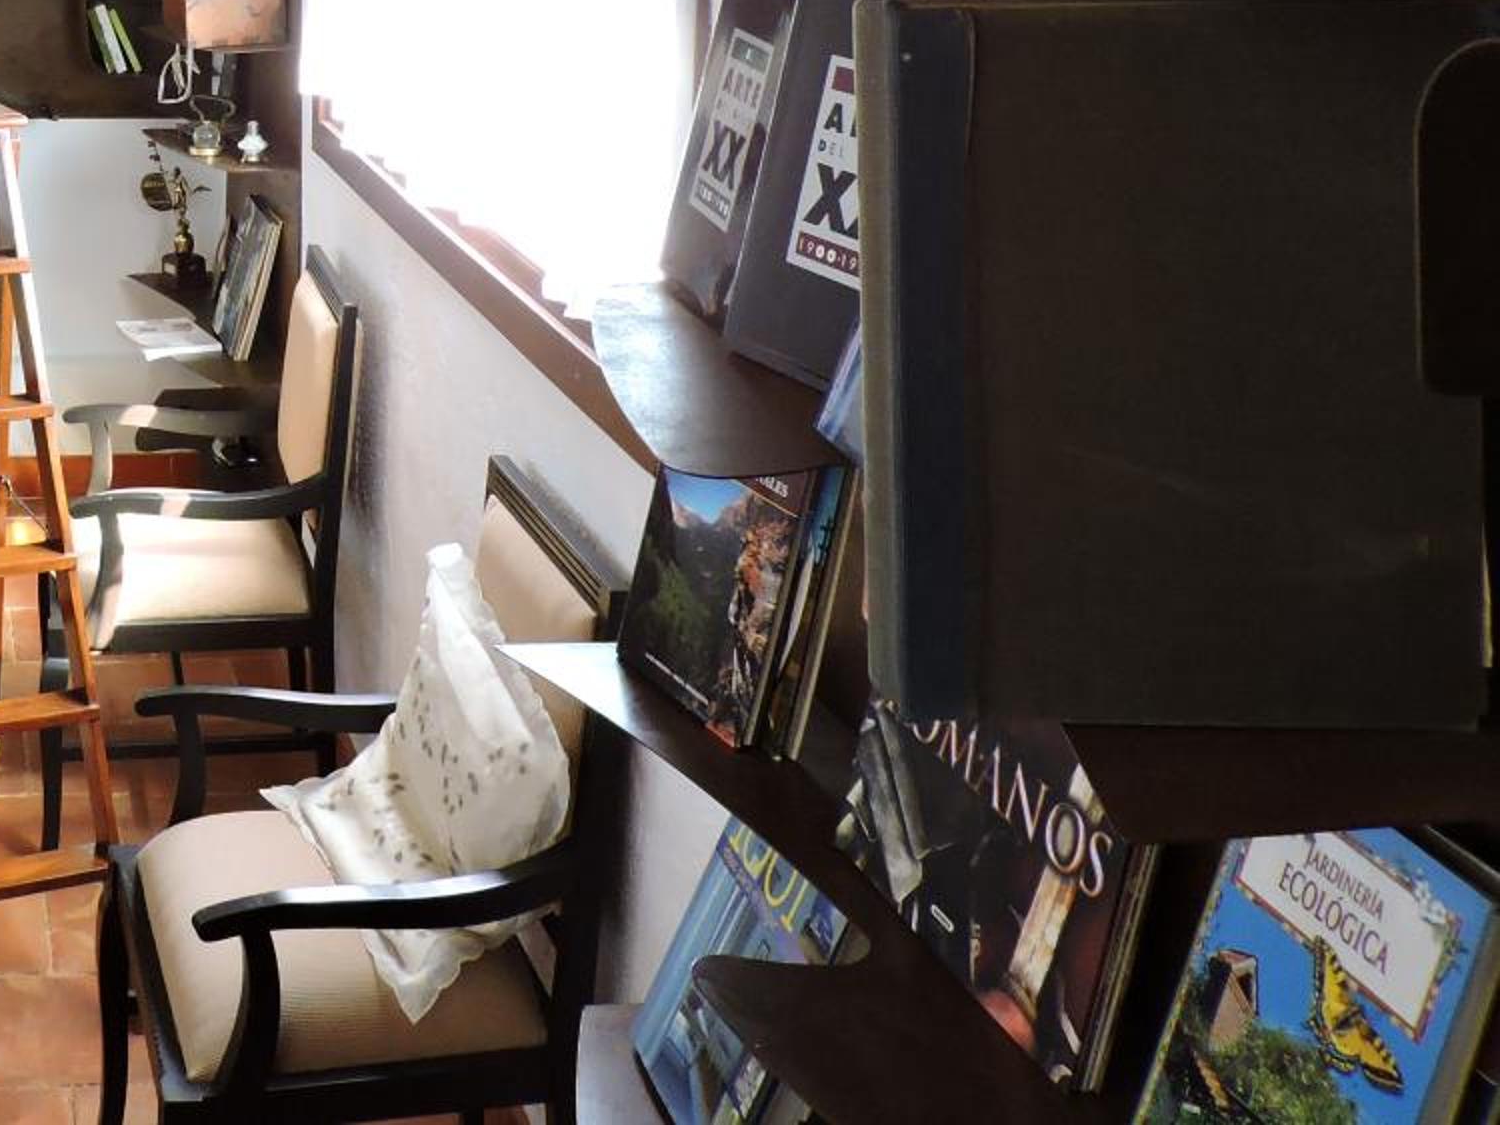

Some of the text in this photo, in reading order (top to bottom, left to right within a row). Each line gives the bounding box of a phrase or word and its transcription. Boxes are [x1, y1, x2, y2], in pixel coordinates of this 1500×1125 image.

[702, 119, 748, 191] XX
[824, 102, 857, 137] A
[1278, 862, 1389, 975] ECOLÓGICA
[1303, 841, 1384, 923] JARDINERÍA
